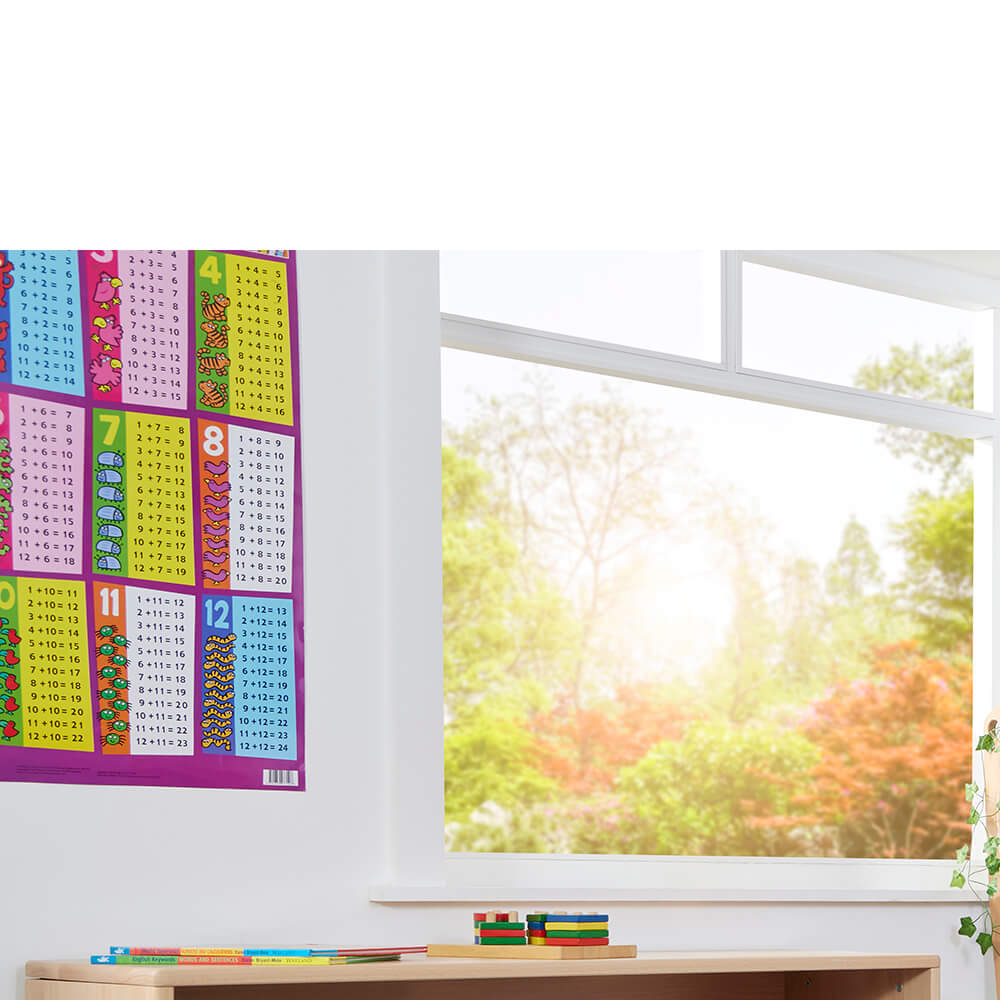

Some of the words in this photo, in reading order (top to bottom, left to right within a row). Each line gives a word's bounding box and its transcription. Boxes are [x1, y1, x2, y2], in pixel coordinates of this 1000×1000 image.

[200, 256, 222, 284] 4
[99, 415, 120, 445] 7
[203, 426, 225, 456] 8
[100, 588, 119, 616] 11
[205, 600, 230, 629] 12
